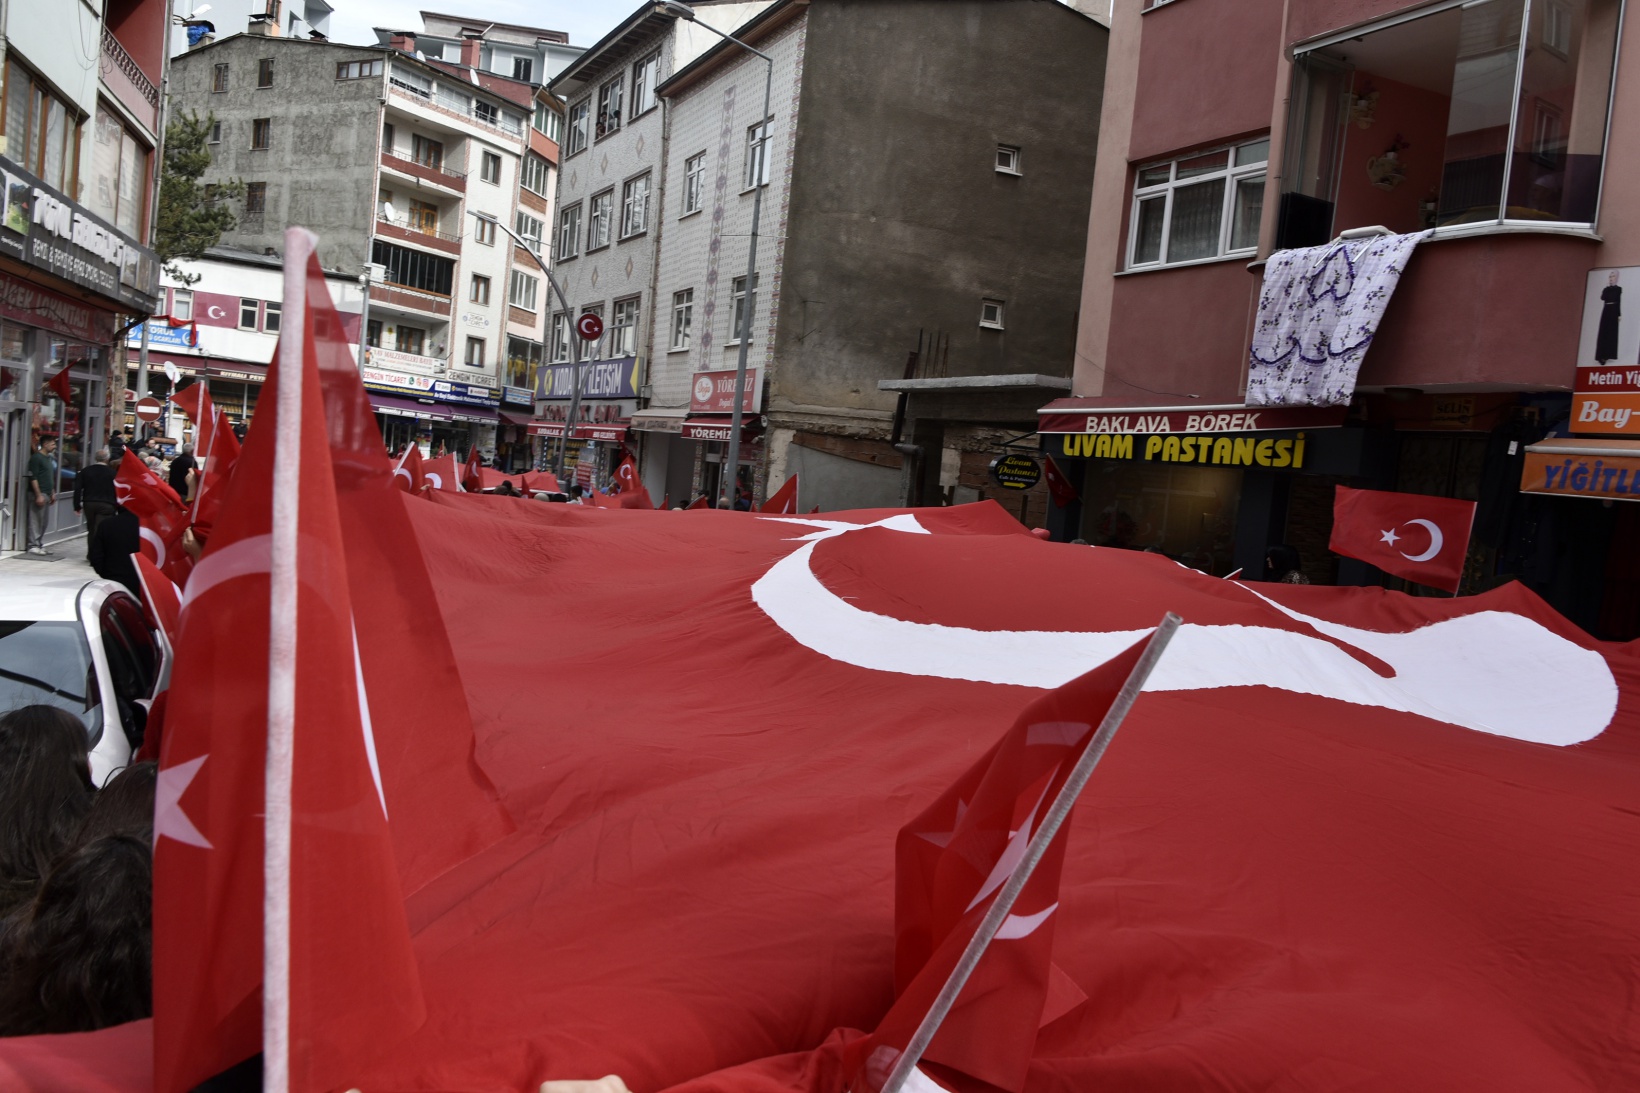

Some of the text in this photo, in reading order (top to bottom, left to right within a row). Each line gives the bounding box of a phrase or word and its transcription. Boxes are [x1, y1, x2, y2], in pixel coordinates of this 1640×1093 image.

[0, 277, 34, 314] İÇEK
[148, 326, 176, 337] ORUL
[553, 363, 623, 397] KODAK İLETİŞİM
[717, 374, 754, 393] YÖREİZ
[1588, 371, 1623, 385] Metin
[1085, 412, 1262, 433] BAKLAVA BÖREK
[1578, 400, 1640, 428] Bay-
[690, 427, 732, 440] YÖREMİZ
[1144, 432, 1305, 468] PASTANESİ
